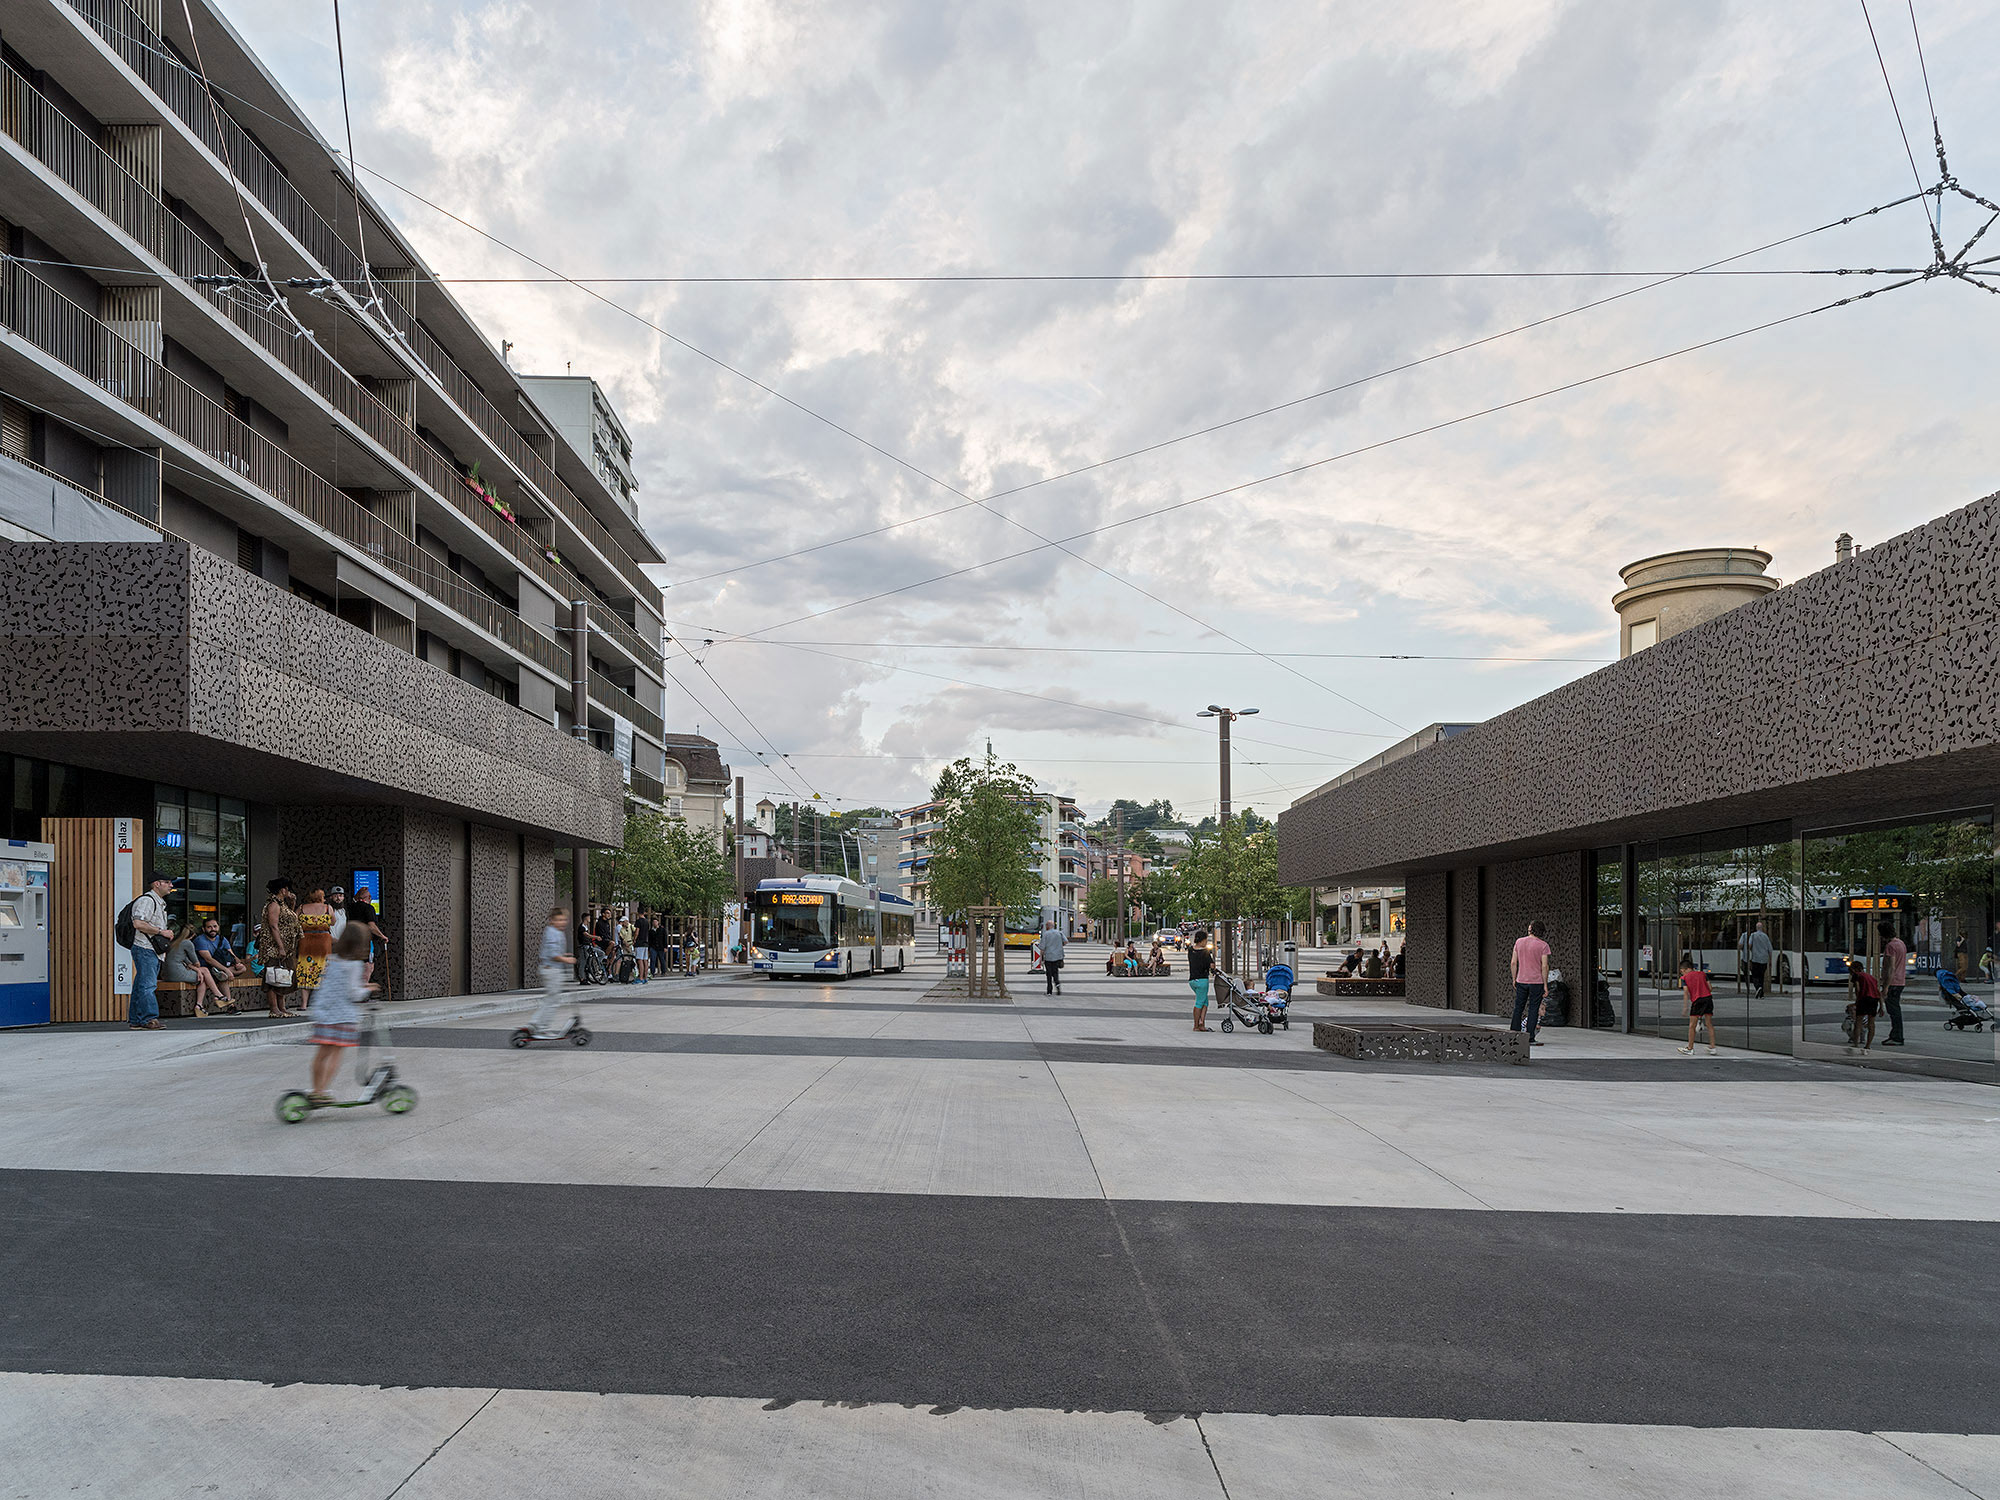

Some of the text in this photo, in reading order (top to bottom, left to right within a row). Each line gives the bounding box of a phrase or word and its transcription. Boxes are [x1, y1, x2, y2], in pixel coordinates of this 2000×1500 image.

[118, 821, 127, 849] Sallaz
[772, 894, 824, 905] 6 PRAZ-SECHAUD
[118, 973, 124, 982] 6
